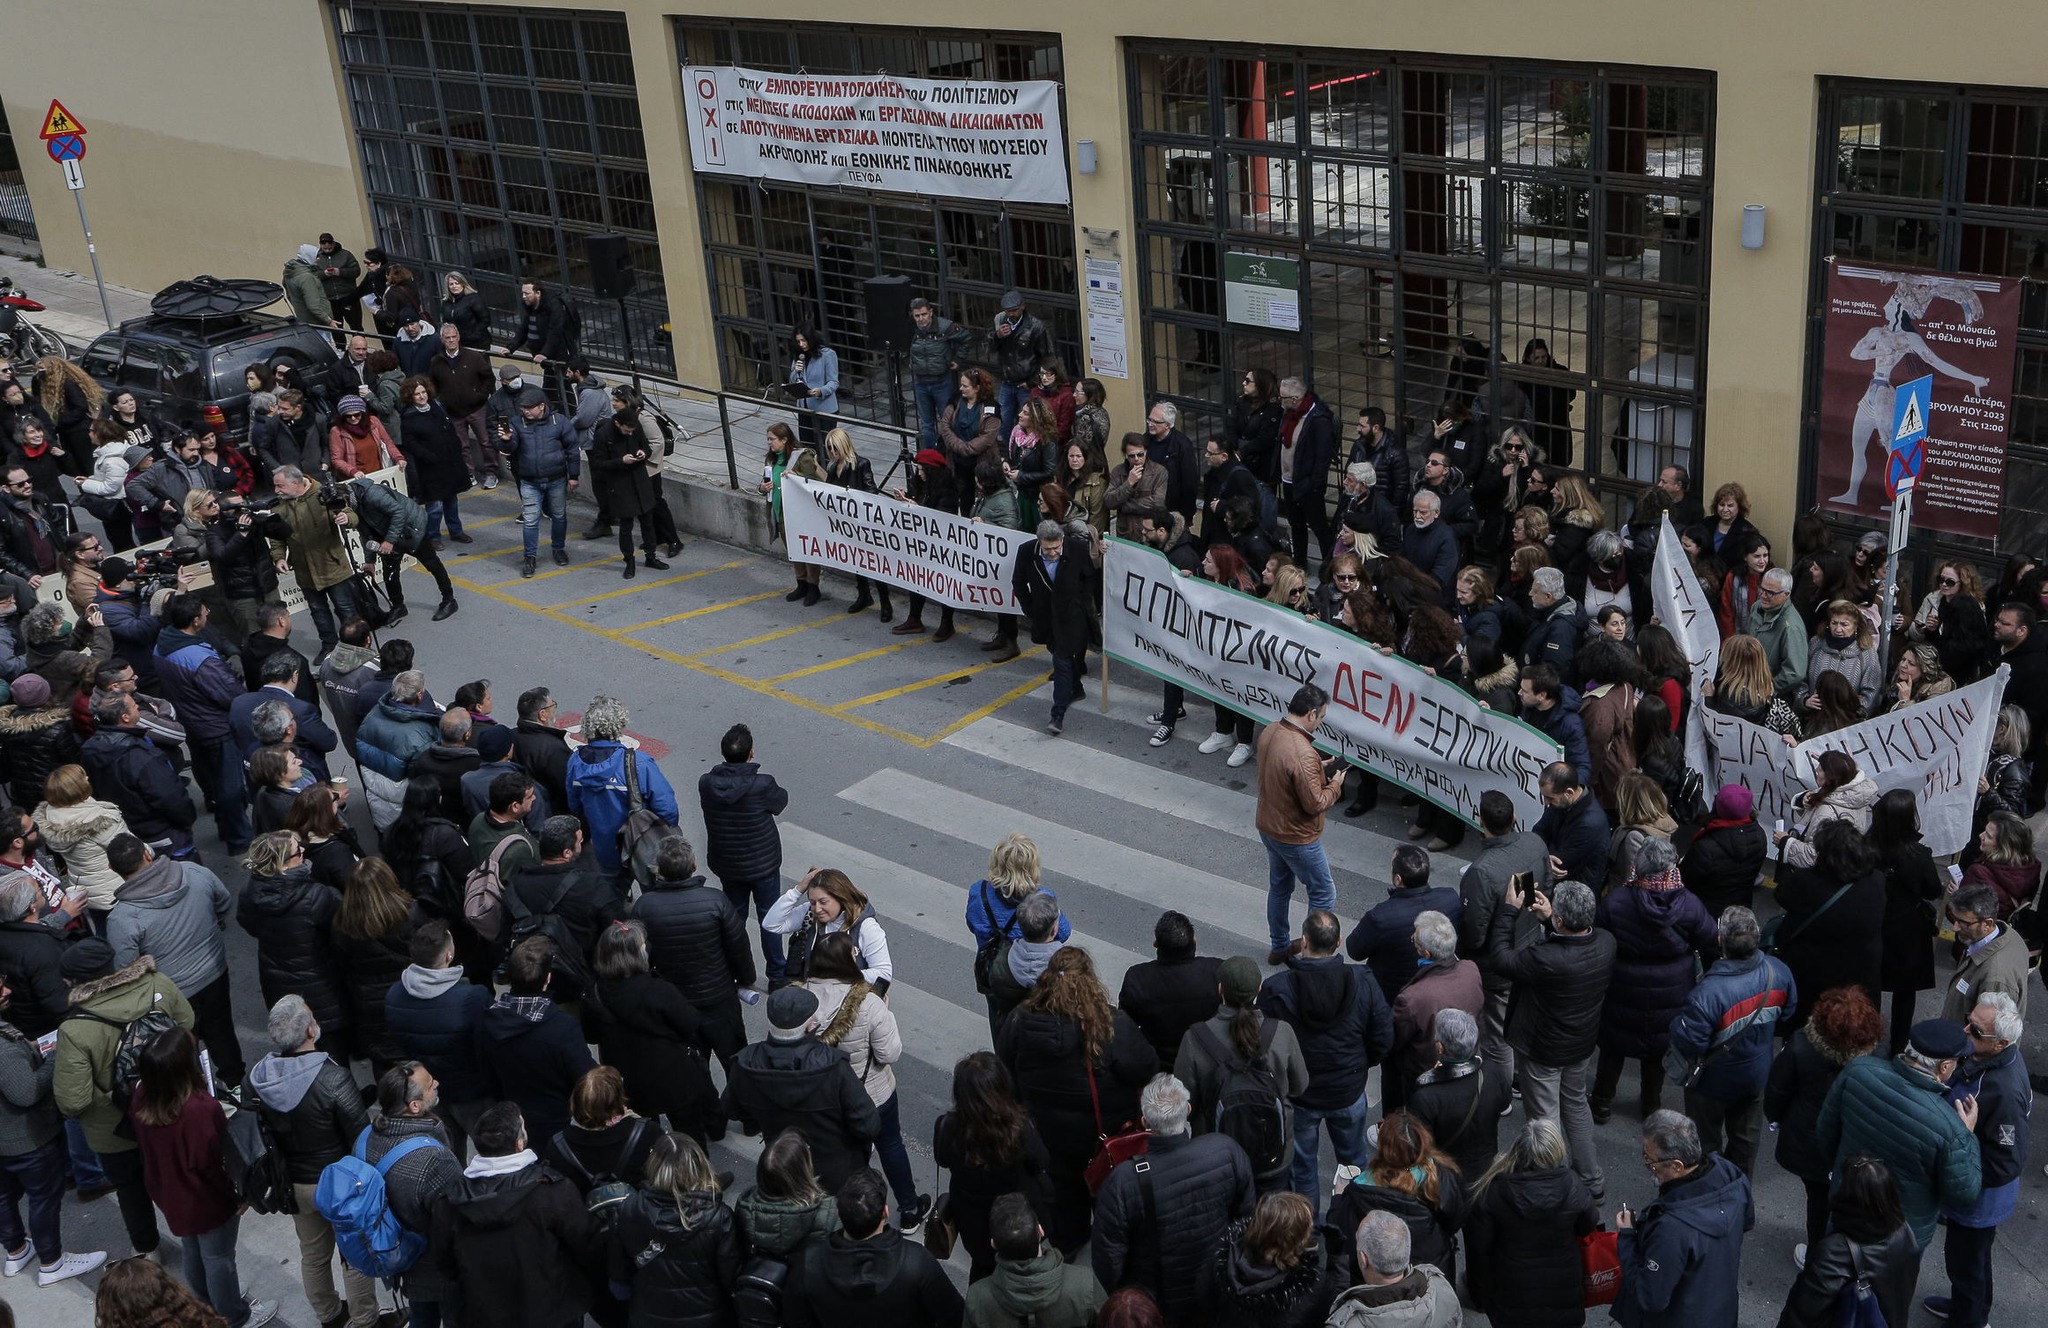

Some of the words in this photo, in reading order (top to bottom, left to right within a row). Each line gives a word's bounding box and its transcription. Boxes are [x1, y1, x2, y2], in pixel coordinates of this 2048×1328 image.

[765, 78, 905, 98] ΕΜΠΟΡΕΥΜΑΤΟΠΟΙΗΣΗ
[906, 88, 927, 101] του
[931, 87, 1018, 105] ΠΟΛΙΤΙΣΜΟΥ
[725, 99, 743, 115] στις
[746, 97, 789, 118] ΜΕΙΩΣΕΙΣ
[792, 104, 857, 121] ΑΠΟΔΟΧΩΝ
[859, 109, 875, 121] και
[879, 106, 947, 127] ΕΡΓΑΣΙΑΚΩΝ
[950, 113, 1044, 130] ΔΙΚΑΙΩΜΑΤΩΝ
[726, 123, 738, 133] σε
[740, 119, 812, 143] ΑΠΟΤΥΧΗΜΕΝΑ
[814, 128, 879, 146] ΕΡΓΑΣΙΑΚΑ
[882, 131, 936, 150] ΜΟΝΤΕΛΑ
[936, 136, 975, 154] ΤΥΠΟΥ
[979, 139, 1048, 155] ΜΟΥΣΕΙΟΥ
[759, 143, 828, 166] ΑΚΡΟΠΟΛΗΣ
[832, 155, 848, 167] και
[851, 152, 910, 171] ΕΘΝΙΚΗΣ
[914, 156, 1013, 179] ΠΙΝΑΚΟΘΗΚΗΣ
[848, 171, 883, 183] ΠΕΥΦΑ
[1957, 323, 1996, 336] Μουσείο
[1926, 331, 1937, 341] δε
[1938, 332, 1962, 343] θέλω
[1963, 336, 1974, 345] να
[1976, 337, 1998, 348] βγώ!
[1963, 394, 2006, 409] Δευτέρα,
[1928, 402, 1982, 416] ΒΡΟΥΑΡΙΟΥ
[1983, 410, 2005, 421] 2023
[1960, 418, 1979, 430] Στις
[1980, 423, 2004, 432] 12:00
[1941, 450, 2003, 465] ΑΡΧΑΙΟΛΟΓΙΚΟΥ
[1959, 442, 1977, 451] στην
[1978, 444, 2004, 454] είσοδο
[1925, 457, 1958, 467] ΟΥΣΕΙΟΥ
[1959, 462, 2002, 474] ΗΡΑΚΛΕΙΟΥ
[813, 490, 859, 519] ΚΑΤΩ
[863, 501, 885, 525] ΤΑ
[890, 508, 942, 539] ΧΕΡΙΑ
[946, 523, 978, 550] ΑΠΟ
[984, 533, 1008, 558] ΤΟ
[828, 515, 900, 552] ΜΟΥΣΕΙΟ
[905, 536, 1000, 580] ΗΡΑΚΛΕΙΟΥ
[799, 535, 822, 558] ΤΑ
[825, 539, 892, 576] ΜΟΥΣΕΙΑ
[896, 560, 965, 602] ΑΝΗΚΟΥΝ
[966, 584, 1003, 607] ΣΤΟ
[1123, 570, 1145, 617] Ο
[1148, 581, 1321, 685] ΠΟΛΙΤΙΣΜΟΣ
[1332, 661, 1416, 735] ΔΕΝ
[1414, 696, 1547, 805] ΞΕΠΟΥΛΙΕΤ
